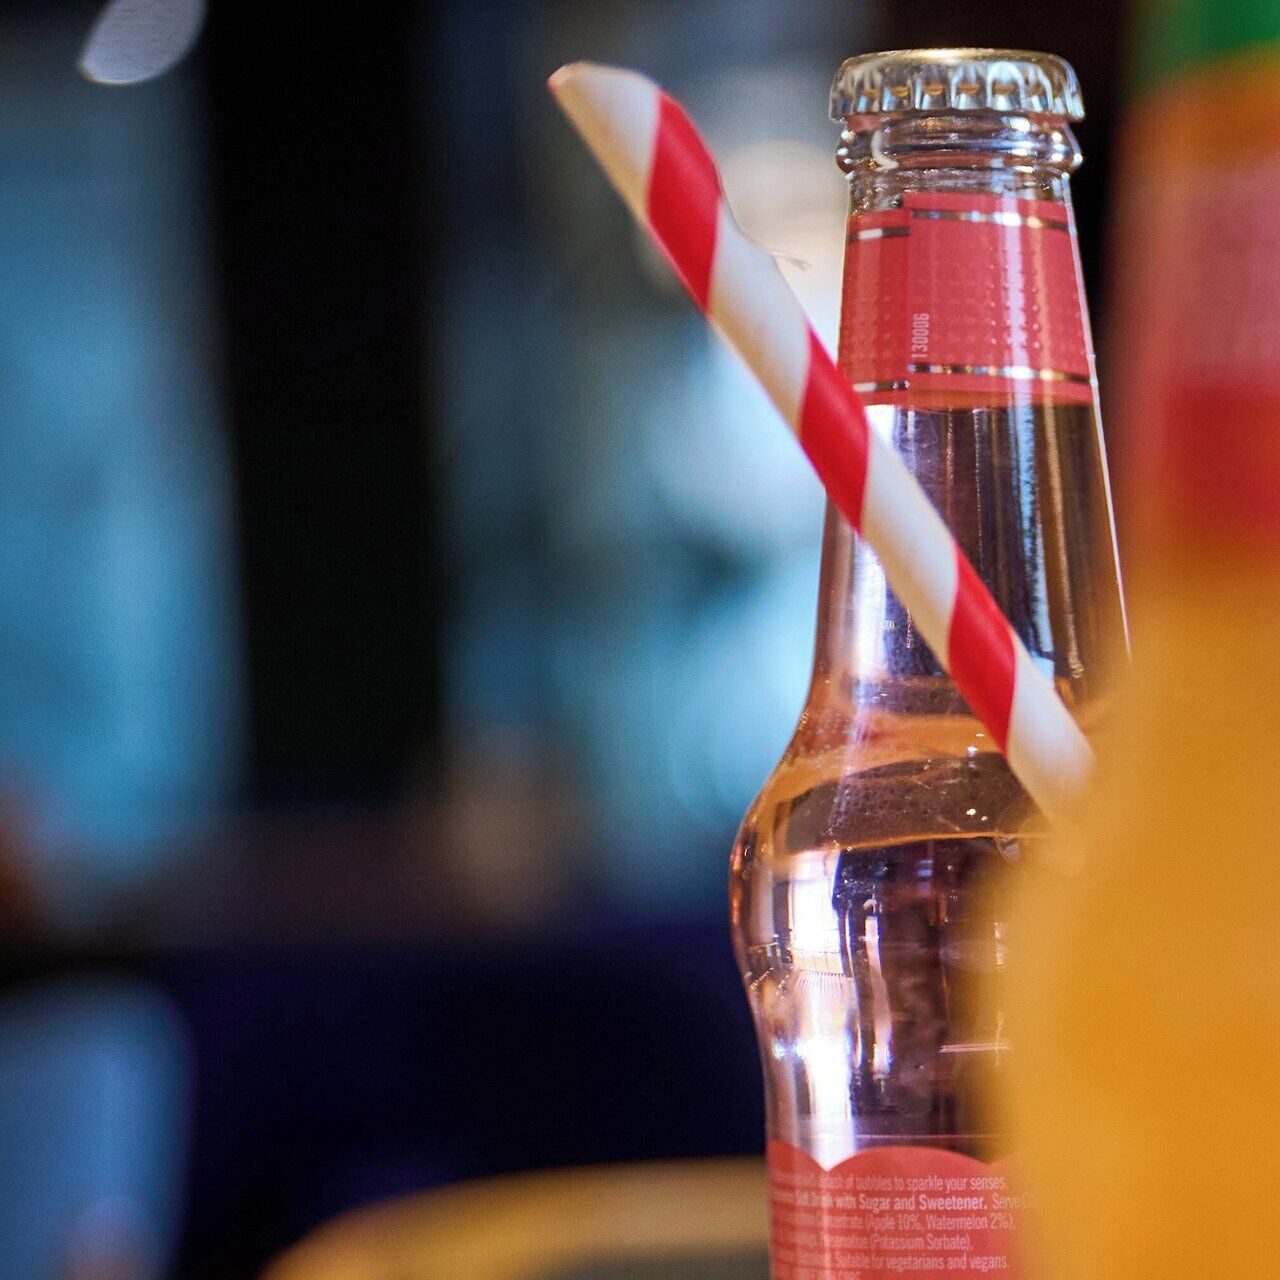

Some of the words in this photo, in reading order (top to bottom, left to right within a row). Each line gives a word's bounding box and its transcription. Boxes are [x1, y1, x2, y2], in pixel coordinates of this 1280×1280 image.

[894, 1175, 904, 1191] to
[906, 1175, 943, 1194] sparkle
[944, 1177, 968, 1194] your
[969, 1176, 1008, 1191] senses.
[858, 1193, 890, 1214] Sugar
[893, 1194, 915, 1210] and
[919, 1194, 988, 1211] Sweetener.
[991, 1192, 1020, 1210] Serve
[926, 1215, 988, 1231] Watermelon
[926, 1233, 974, 1252] Sorbate).
[885, 1254, 945, 1273] vegetarians
[946, 1253, 967, 1270] and
[969, 1256, 1010, 1273] vegans.
